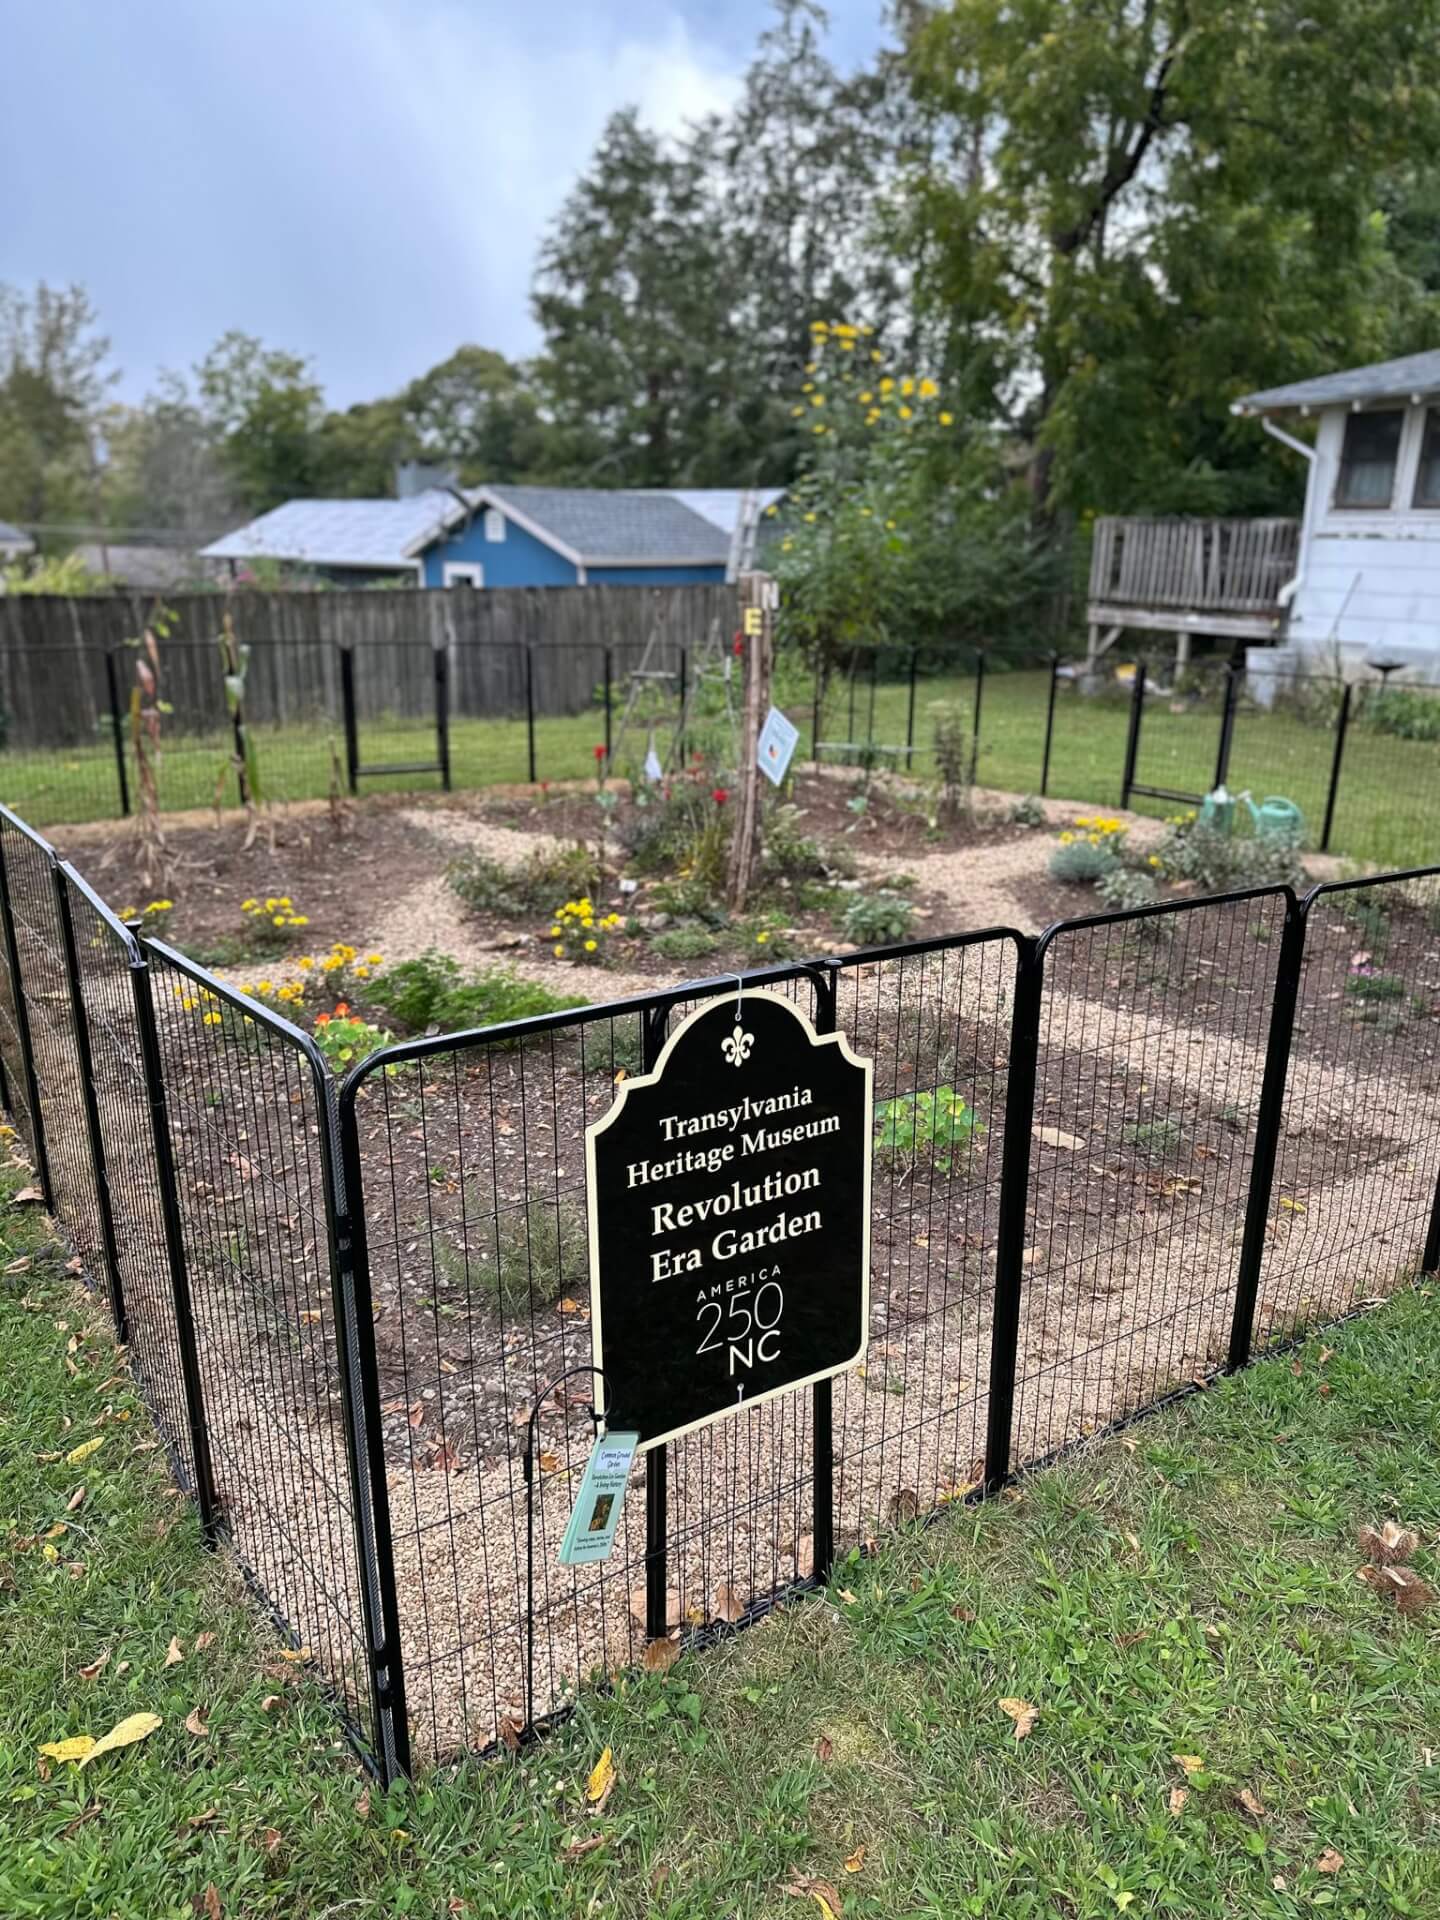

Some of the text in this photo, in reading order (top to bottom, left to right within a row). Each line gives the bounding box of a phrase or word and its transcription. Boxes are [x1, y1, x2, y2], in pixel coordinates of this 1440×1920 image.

[744, 608, 763, 635] E
[659, 1086, 813, 1142] Transylvania
[626, 1115, 842, 1189] Heritage Museum
[650, 1167, 822, 1236] Revolution
[650, 1210, 823, 1283] Era Garden
[695, 1264, 783, 1304] AMERICA
[695, 1281, 784, 1355] 250
[728, 1329, 782, 1377] NC
